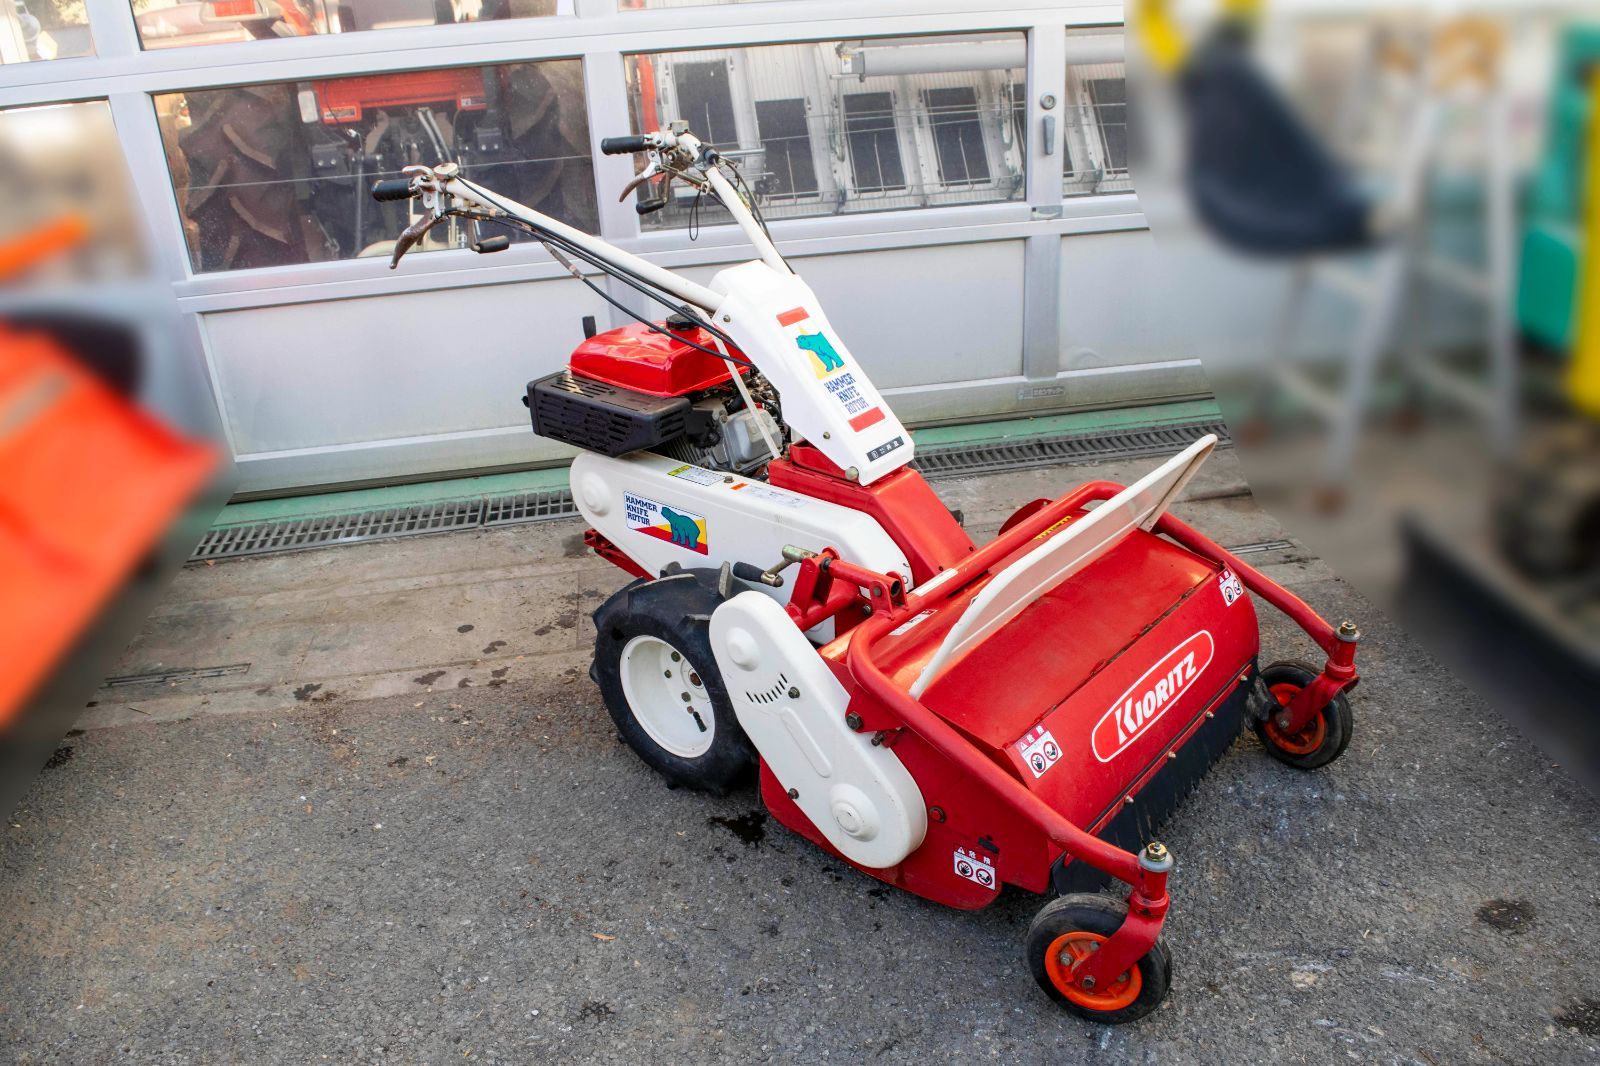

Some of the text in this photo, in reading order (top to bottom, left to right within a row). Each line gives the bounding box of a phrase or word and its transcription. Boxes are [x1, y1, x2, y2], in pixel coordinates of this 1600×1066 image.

[824, 373, 856, 393] HAMMER
[836, 386, 860, 403] KNIFE
[845, 397, 870, 414] ROTOR
[625, 495, 658, 512] HAMMER
[626, 503, 649, 517] KNIFE
[627, 512, 651, 526] ROTOR
[1114, 651, 1197, 745] KIORITZ
